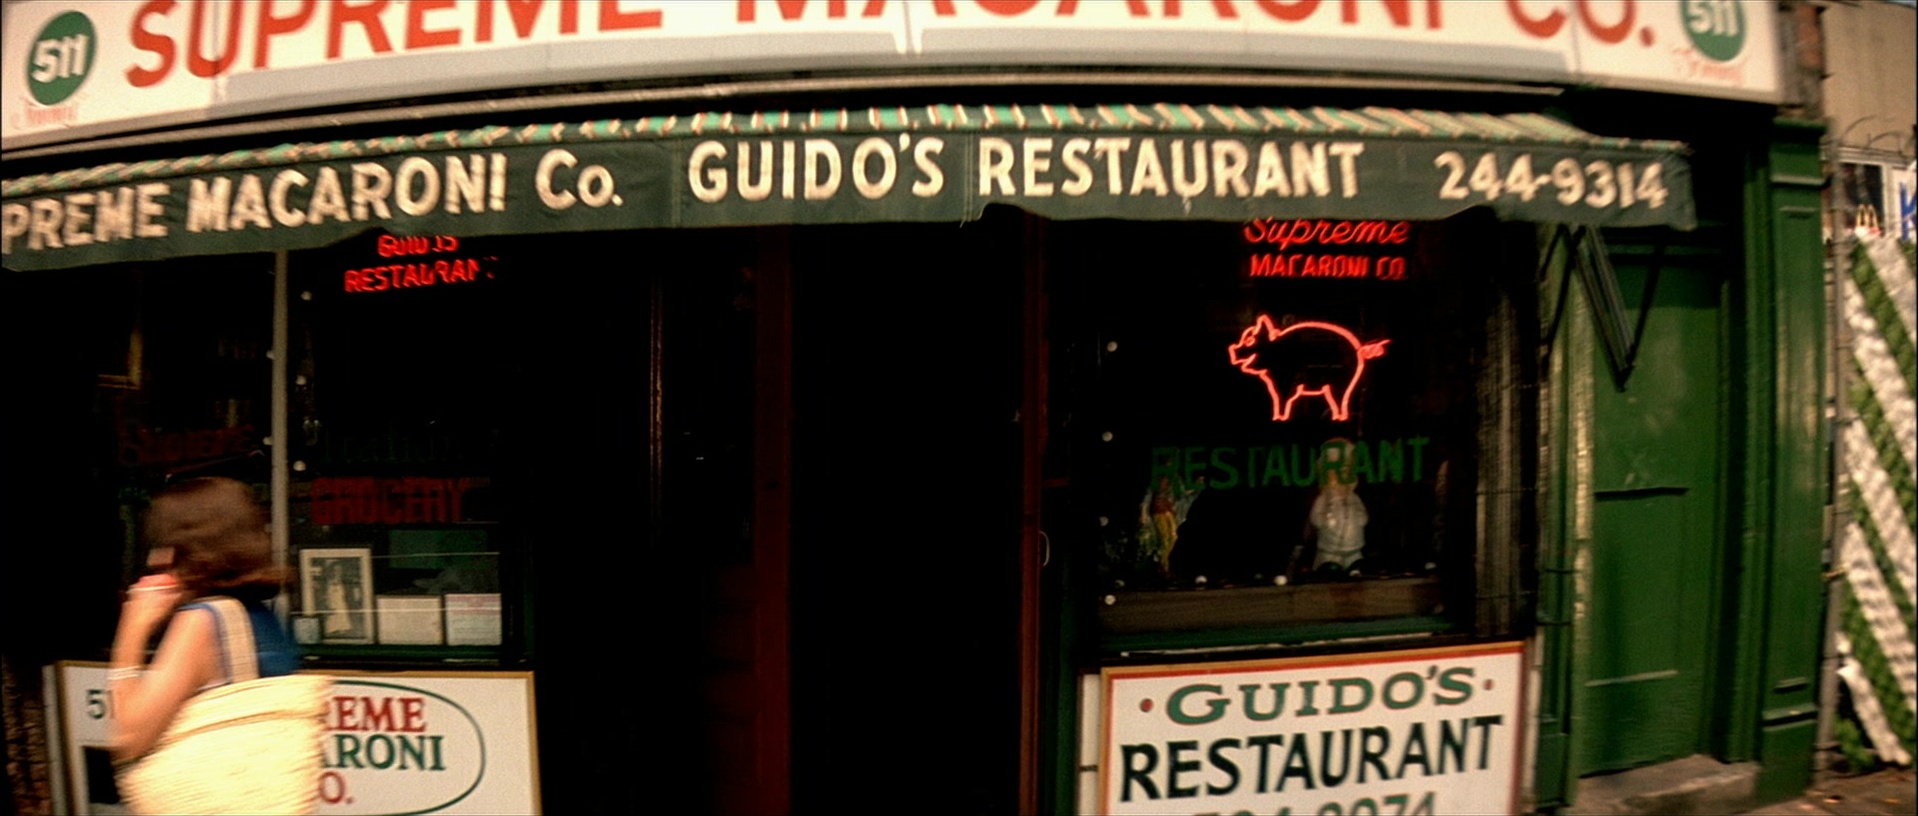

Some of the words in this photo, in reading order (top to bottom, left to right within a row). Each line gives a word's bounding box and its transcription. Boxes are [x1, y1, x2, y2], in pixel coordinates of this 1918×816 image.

[31, 34, 88, 83] 511
[186, 152, 507, 232] MACARONI
[535, 149, 623, 210] Co.
[688, 133, 945, 202] GUIDO'S
[978, 136, 1365, 199] RESTAURANT
[1434, 151, 1669, 209] 244-9314
[1244, 217, 1410, 251] Supreme
[1250, 253, 1369, 278] MACARONI
[1151, 436, 1431, 496] RESTAURANT
[311, 475, 470, 524] GROCERY
[1166, 665, 1475, 726] GUIDO'S
[1120, 714, 1504, 802] RESTAURANT
